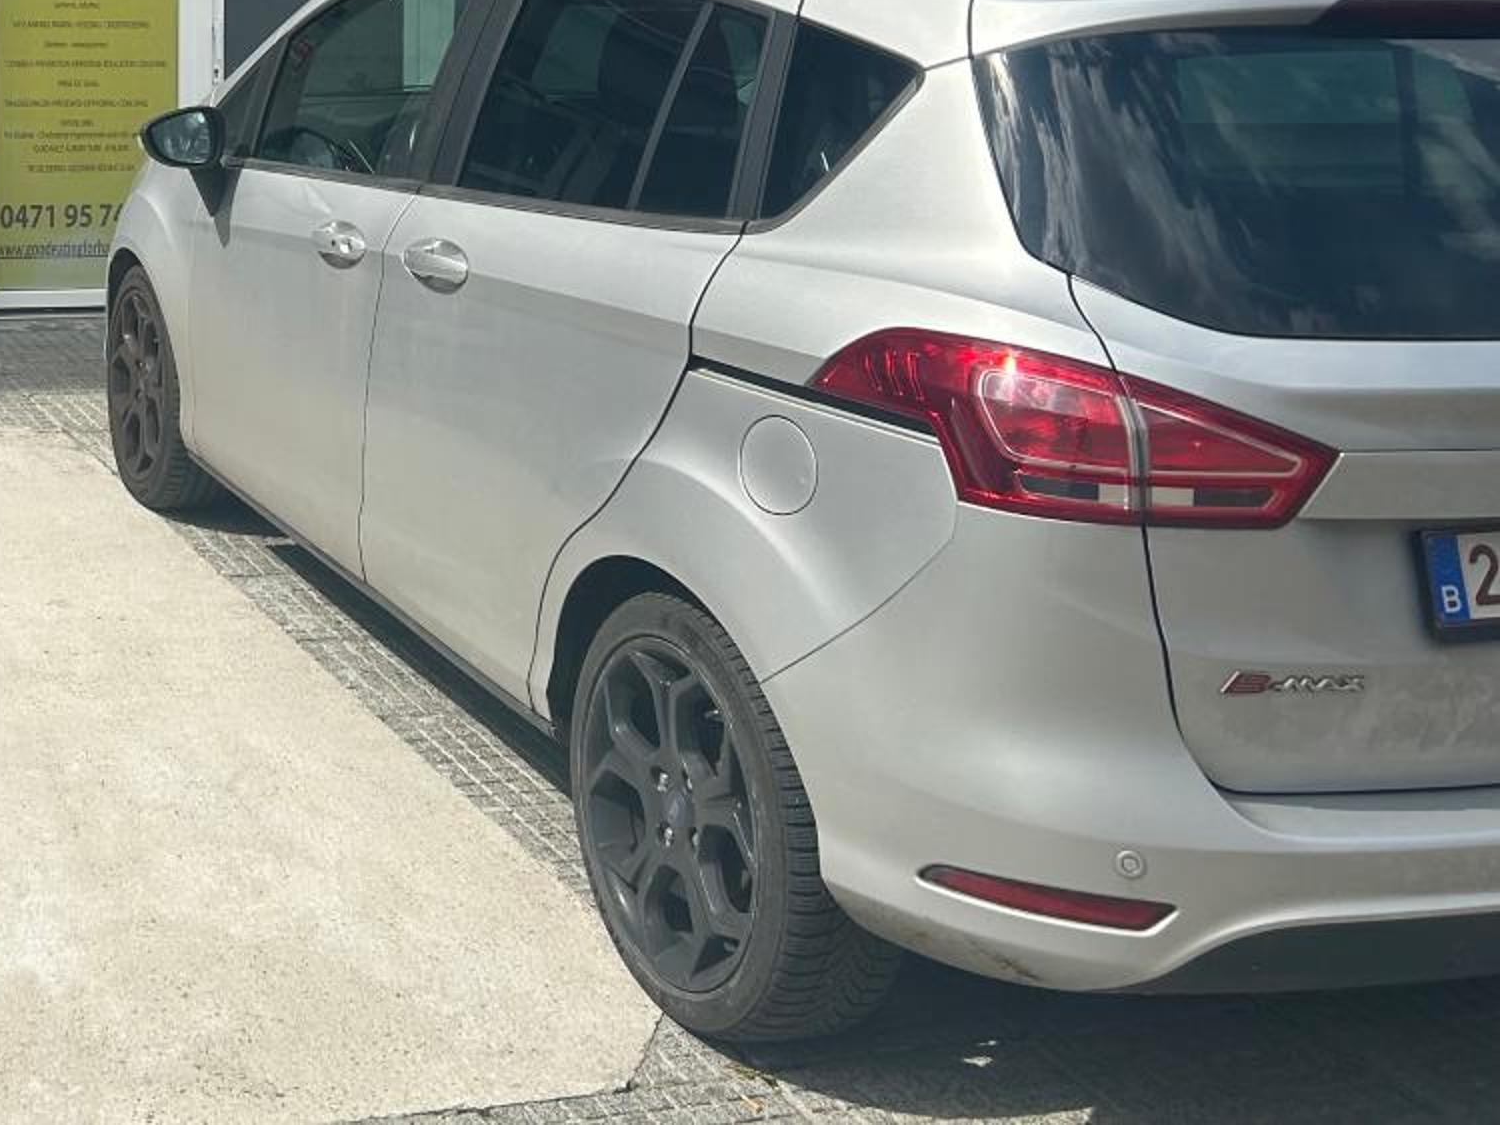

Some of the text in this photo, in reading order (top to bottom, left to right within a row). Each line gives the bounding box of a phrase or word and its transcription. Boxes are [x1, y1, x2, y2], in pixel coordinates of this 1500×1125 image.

[0, 204, 55, 229] 0471
[64, 203, 92, 228] 95
[1440, 544, 1500, 613] B 2
